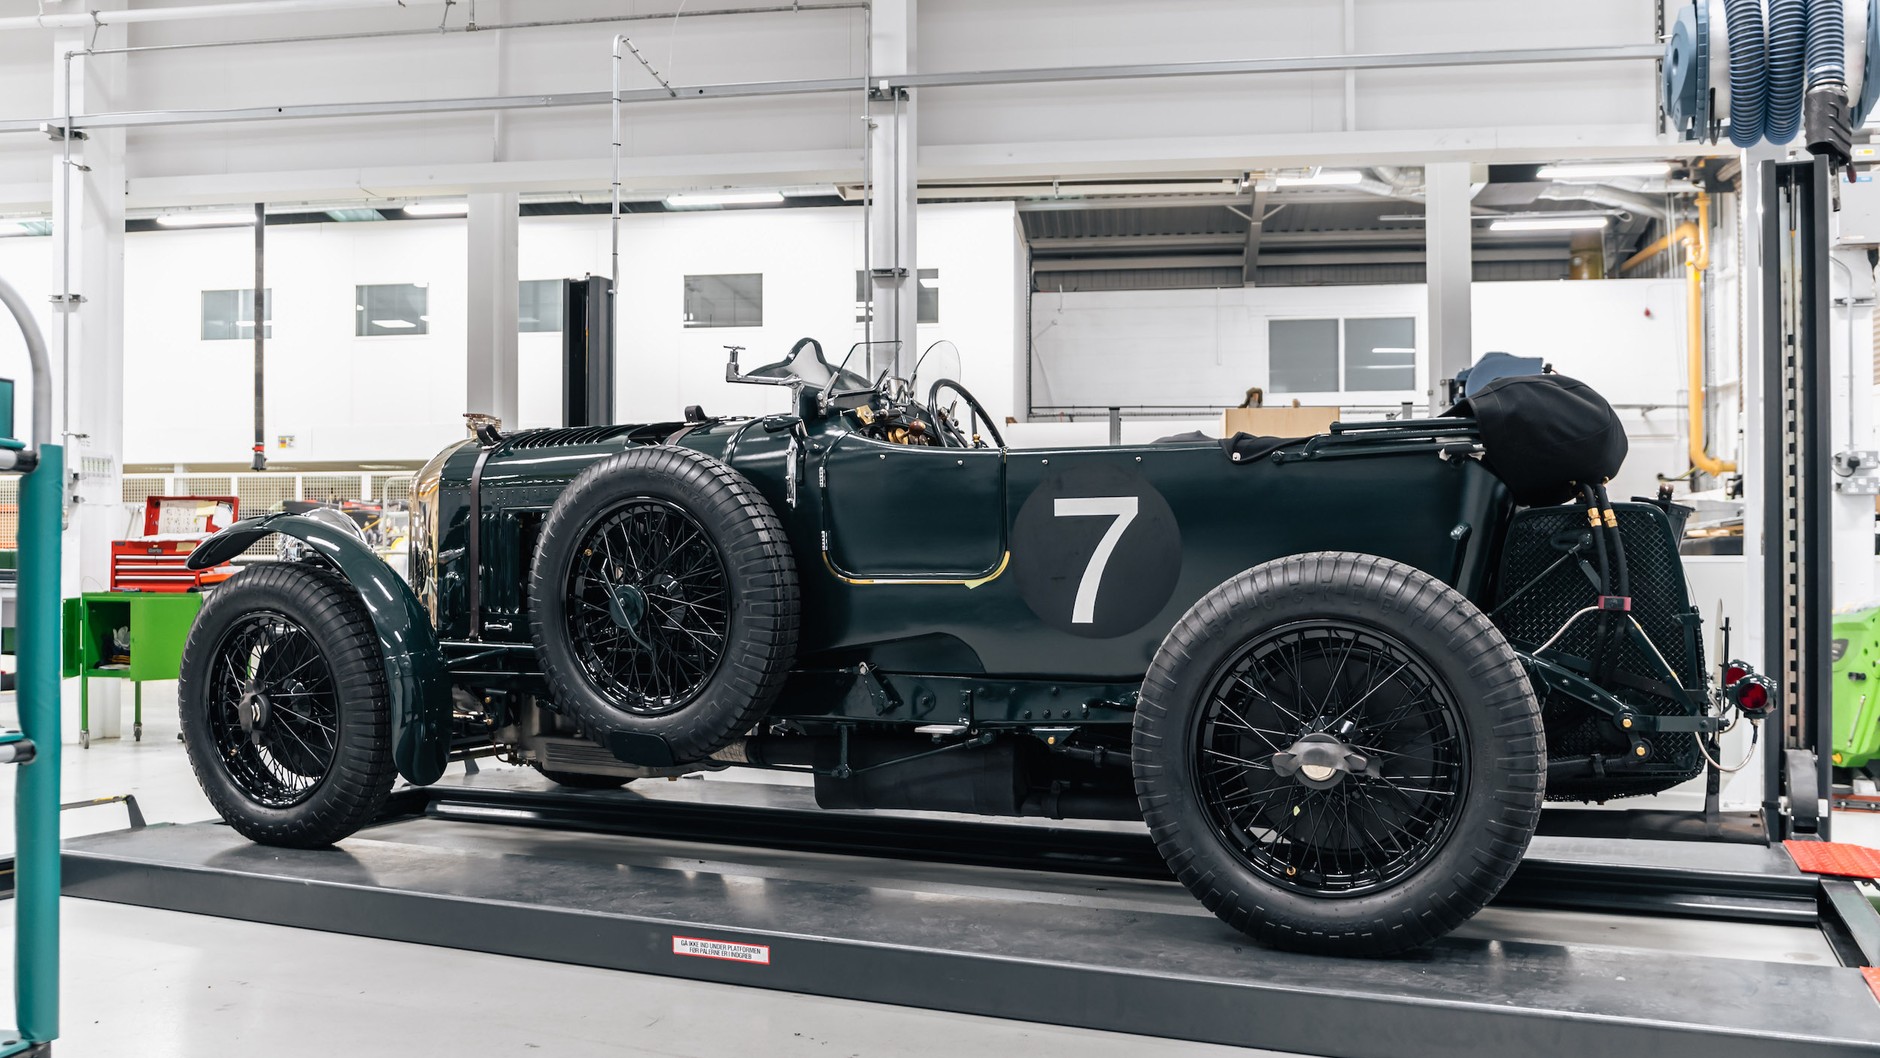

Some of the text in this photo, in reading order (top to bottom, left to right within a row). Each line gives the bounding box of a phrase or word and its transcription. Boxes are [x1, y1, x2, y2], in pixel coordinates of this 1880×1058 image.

[1054, 496, 1138, 623] 7
[710, 942, 726, 950] UNDER
[727, 944, 761, 954] PLATFORMEN
